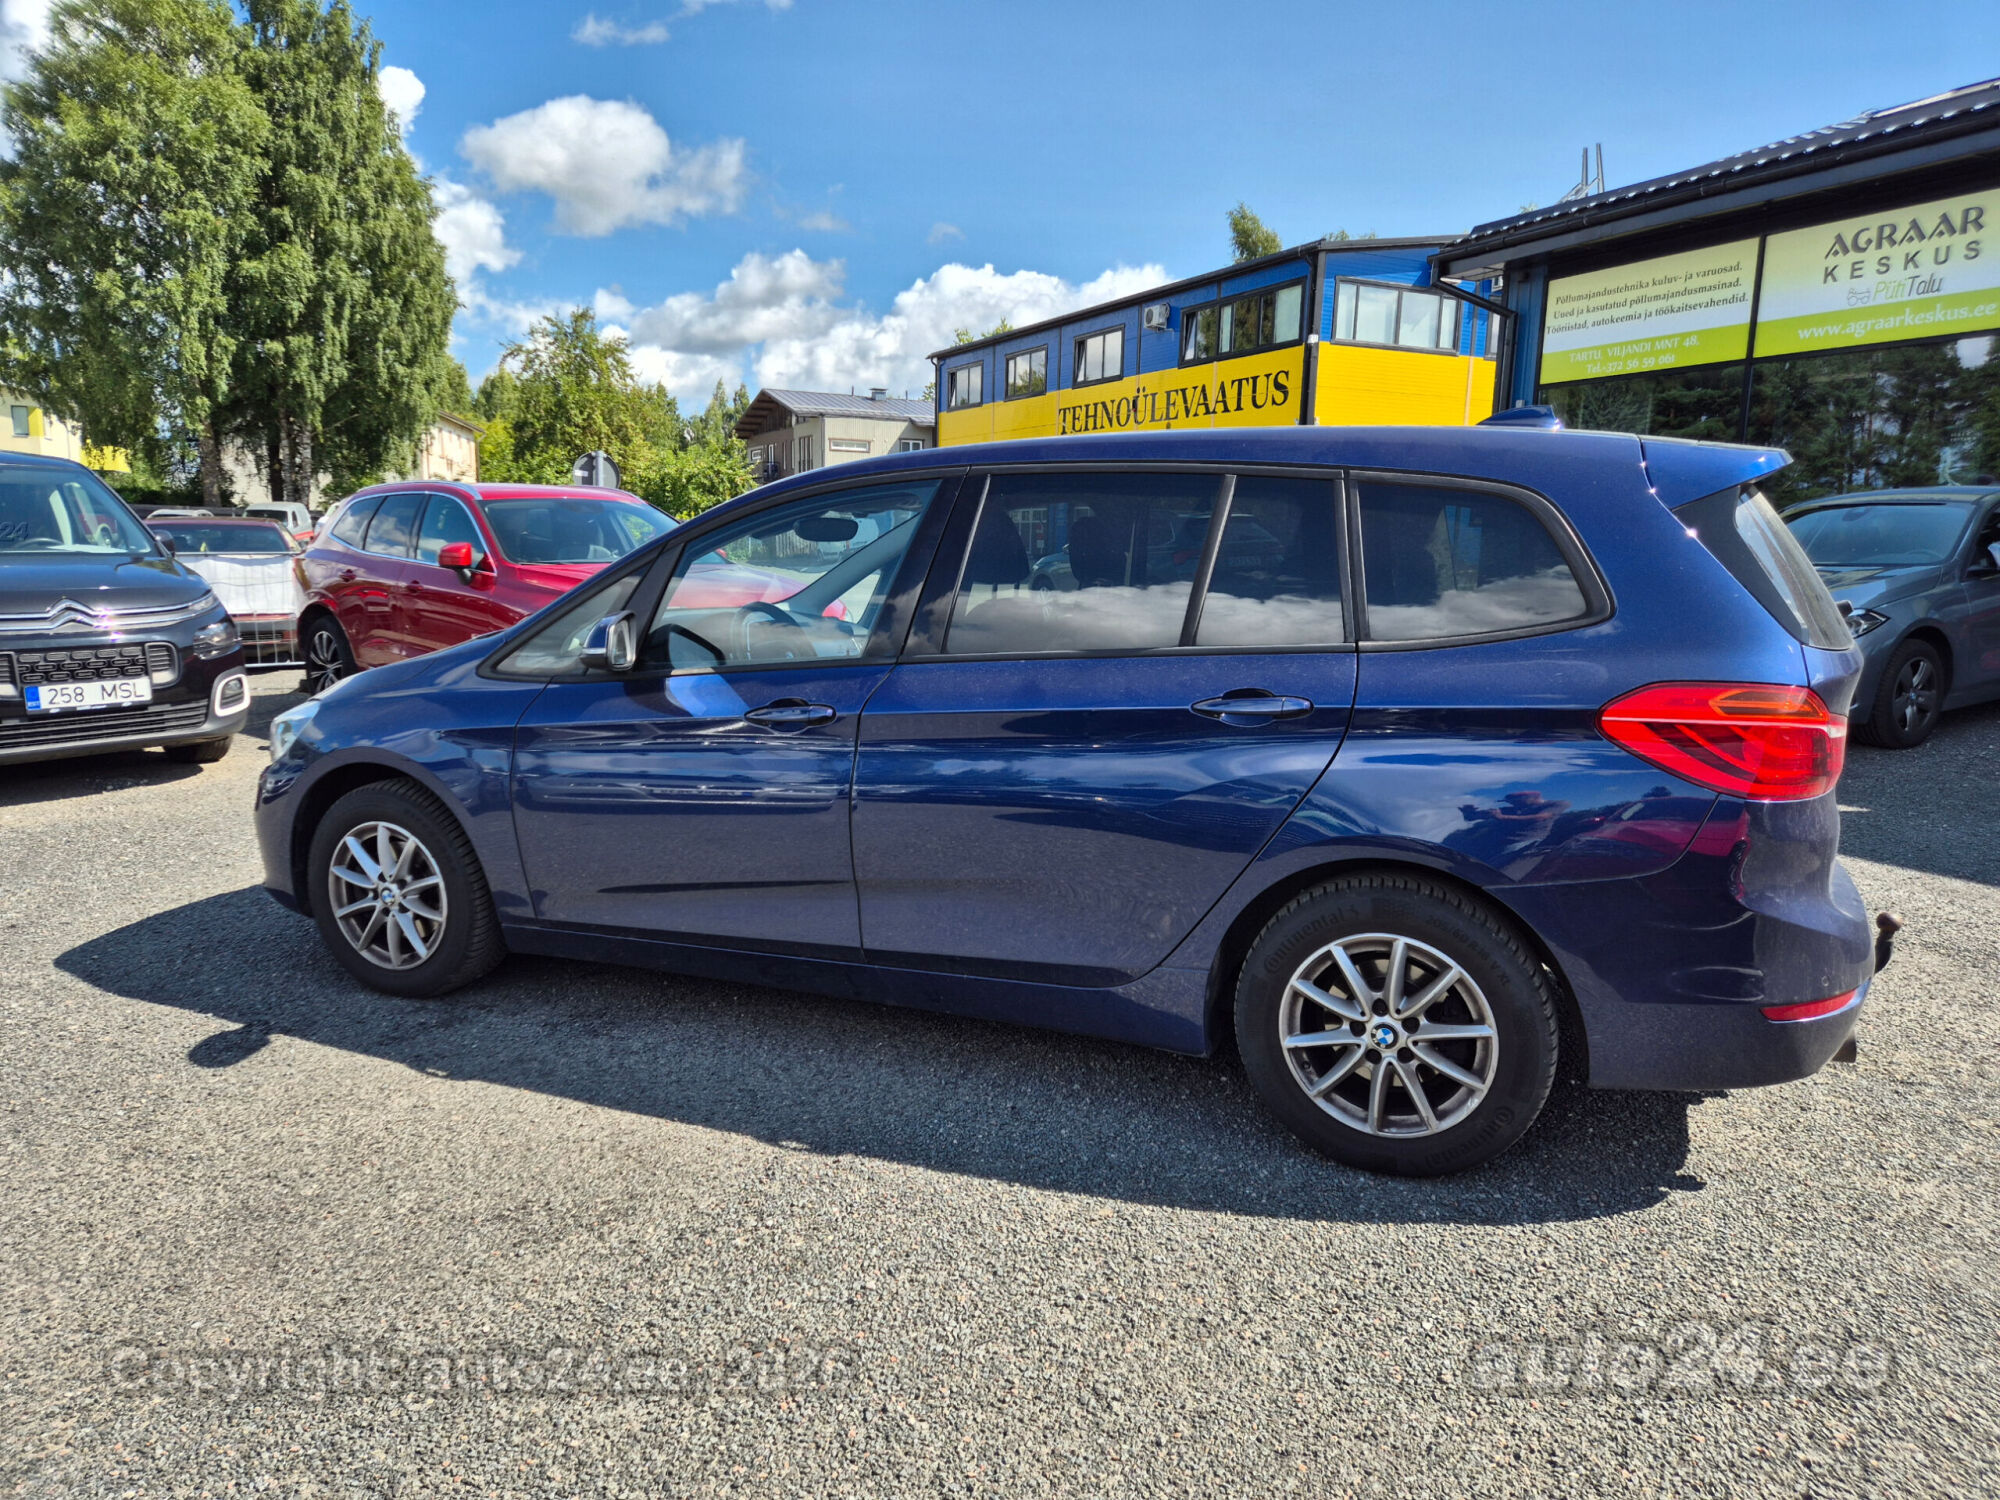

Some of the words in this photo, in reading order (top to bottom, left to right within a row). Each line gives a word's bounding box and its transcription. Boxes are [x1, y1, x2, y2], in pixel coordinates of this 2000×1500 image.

[1824, 206, 1987, 260] AGRAAR
[1555, 281, 1650, 305] Põllumajandustehnika
[1652, 275, 1682, 287] kuluv-
[1684, 271, 1693, 282] ja
[1696, 261, 1743, 279] varuosad.
[1822, 240, 1983, 285] KESKUS
[1546, 319, 1590, 335] Tööriistad,
[1591, 310, 1642, 327] autokeemia
[1644, 310, 1653, 320] ja
[1655, 292, 1748, 316] töökaitsevahendid.
[1553, 307, 1575, 320] Uued
[1576, 306, 1584, 317] ja
[1586, 298, 1627, 314] kasutatud
[1629, 277, 1742, 309] põllumajandusmasinad.
[1797, 302, 1997, 339] www.agraarkeskus.ee
[1608, 341, 1652, 358] VILJANDI
[1655, 337, 1680, 350] MNT
[1626, 358, 1639, 370] 56
[1642, 356, 1656, 369] 59
[1058, 370, 1290, 435] TEHNOÜLEVAATUS
[49, 687, 85, 705] 258
[101, 682, 145, 700] MSL
